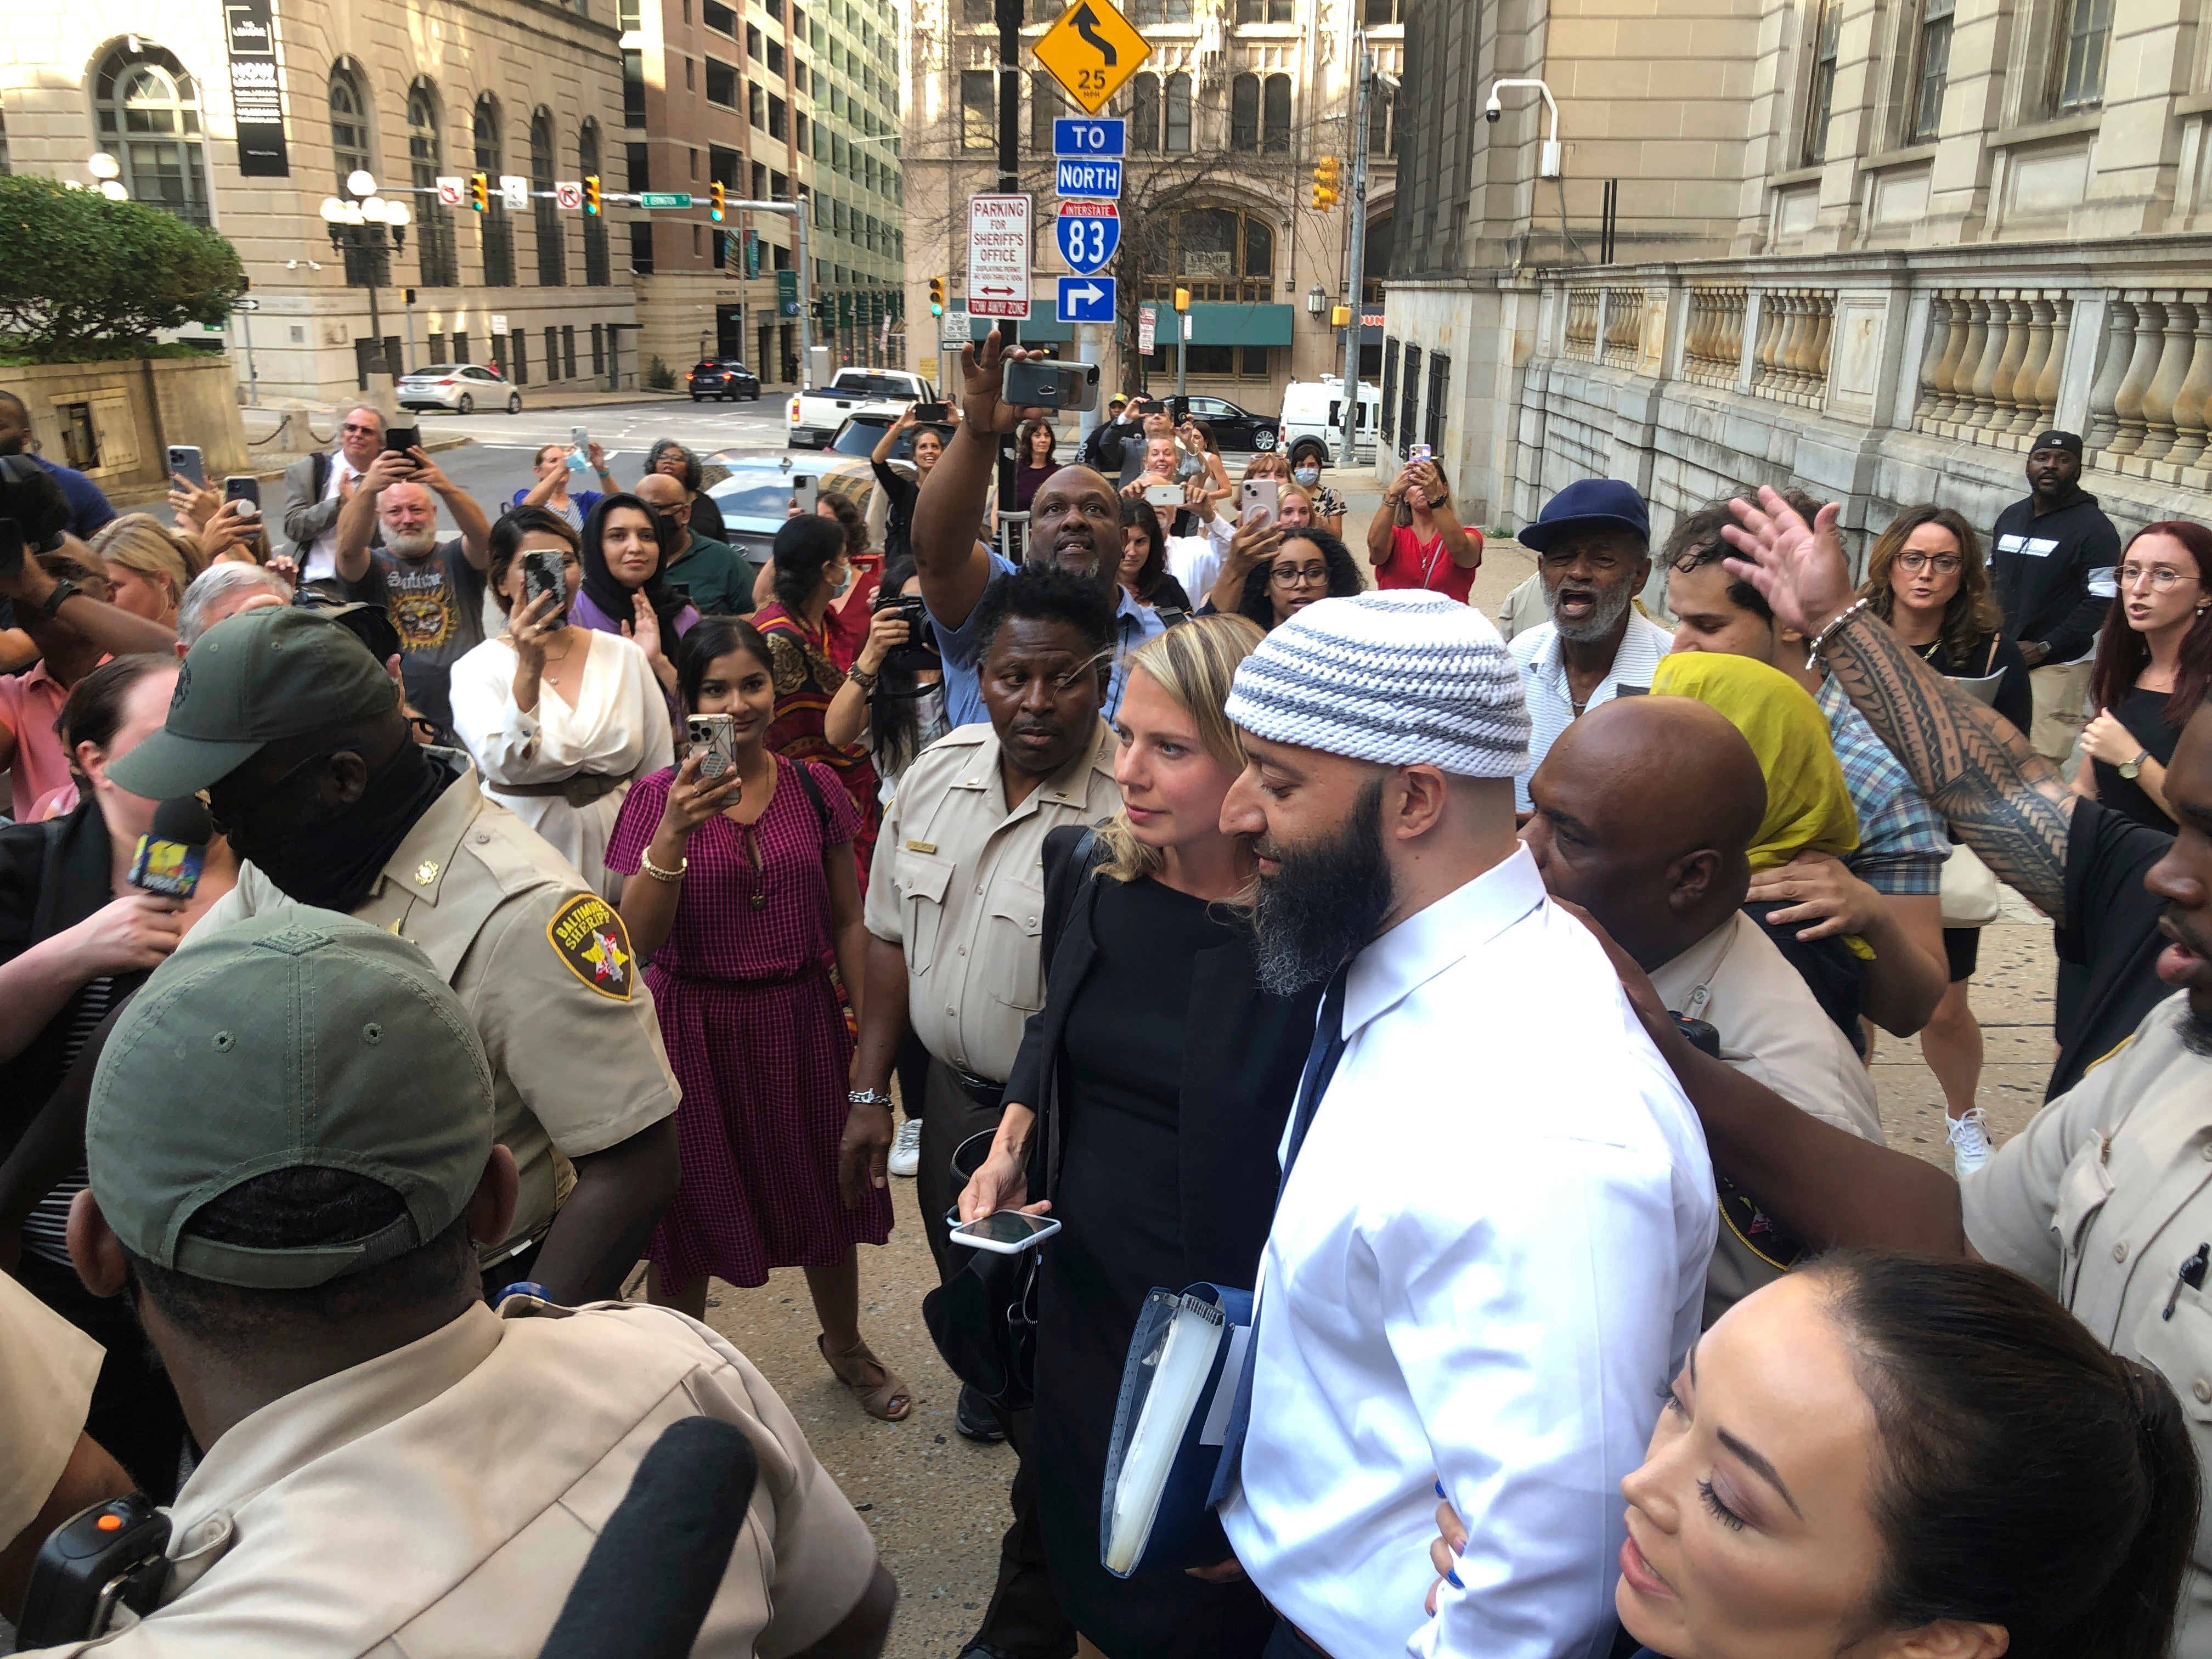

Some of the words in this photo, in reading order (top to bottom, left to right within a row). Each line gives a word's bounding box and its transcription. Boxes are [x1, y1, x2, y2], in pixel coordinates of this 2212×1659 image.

[1077, 69, 1106, 91] 25
[1071, 126, 1105, 149] TO
[1060, 164, 1117, 190] NORTH
[974, 202, 1024, 217] PARKING
[1065, 204, 1110, 216] INTERSTATE
[990, 219, 1007, 230] FOR
[973, 233, 1024, 246] SHERIFF'S
[1068, 219, 1104, 263] 83
[980, 250, 1016, 262] OFFICE
[970, 300, 986, 313] TOW
[988, 301, 1006, 314] AWAY
[1007, 302, 1026, 315] ZONE
[565, 911, 610, 951] SHERIFF
